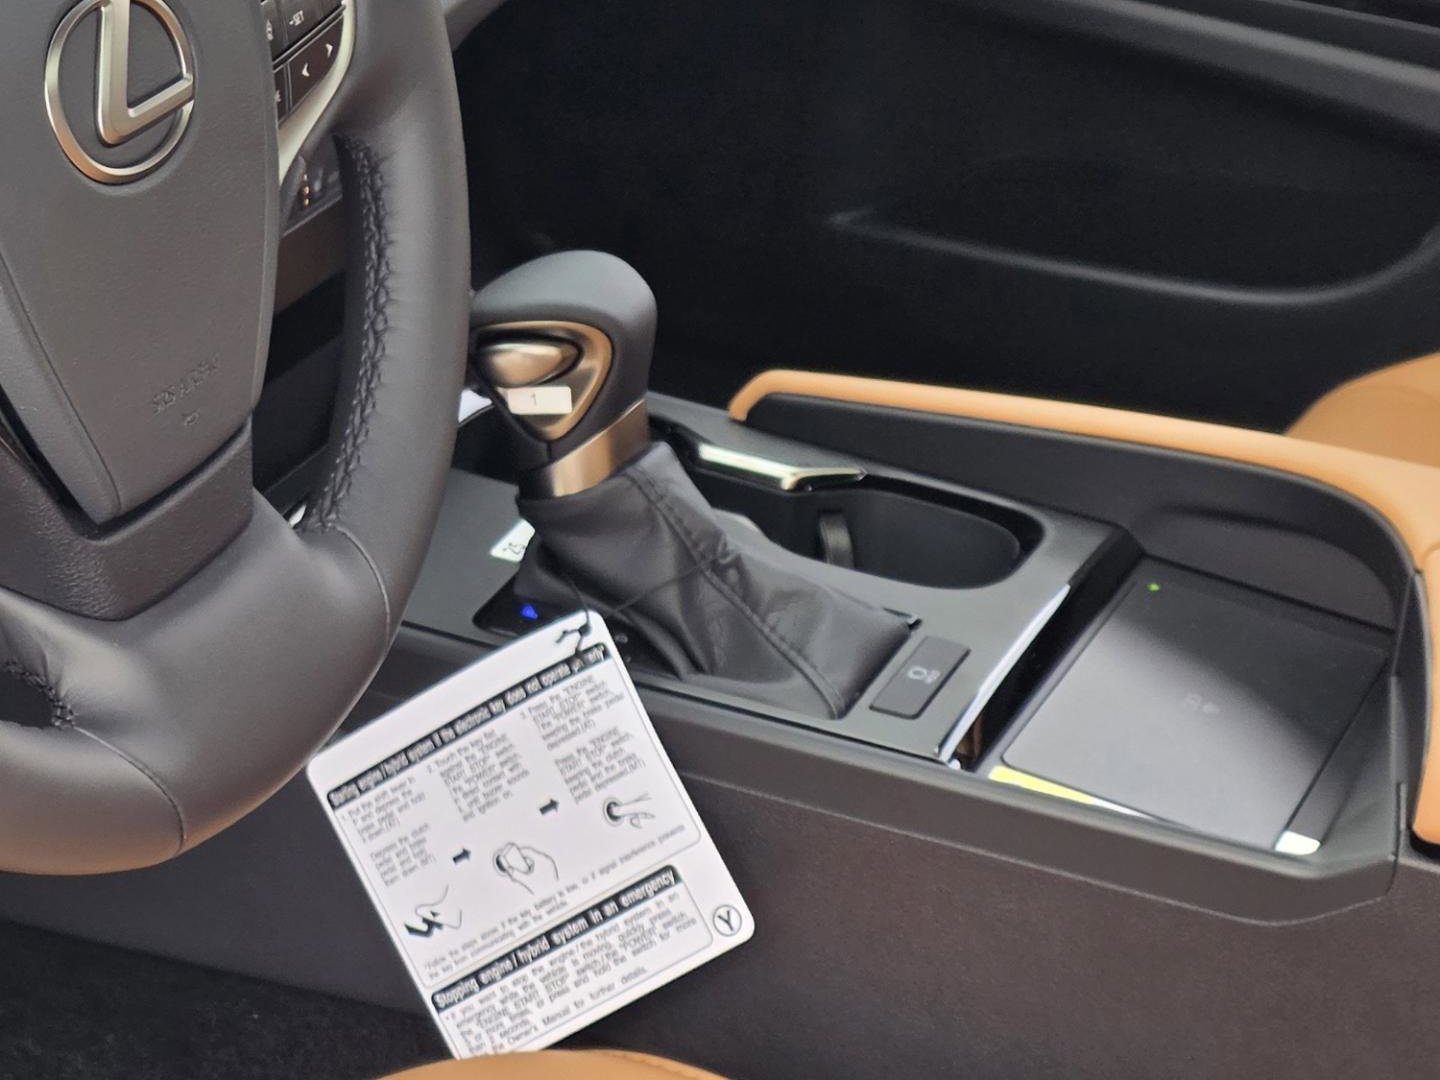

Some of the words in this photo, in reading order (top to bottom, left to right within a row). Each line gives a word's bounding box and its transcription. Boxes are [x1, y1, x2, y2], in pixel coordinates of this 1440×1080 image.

[434, 974, 480, 1011] Stopping
[548, 914, 590, 949] system
[587, 906, 603, 925] in
[601, 898, 619, 917] an
[617, 867, 677, 911] emergency
